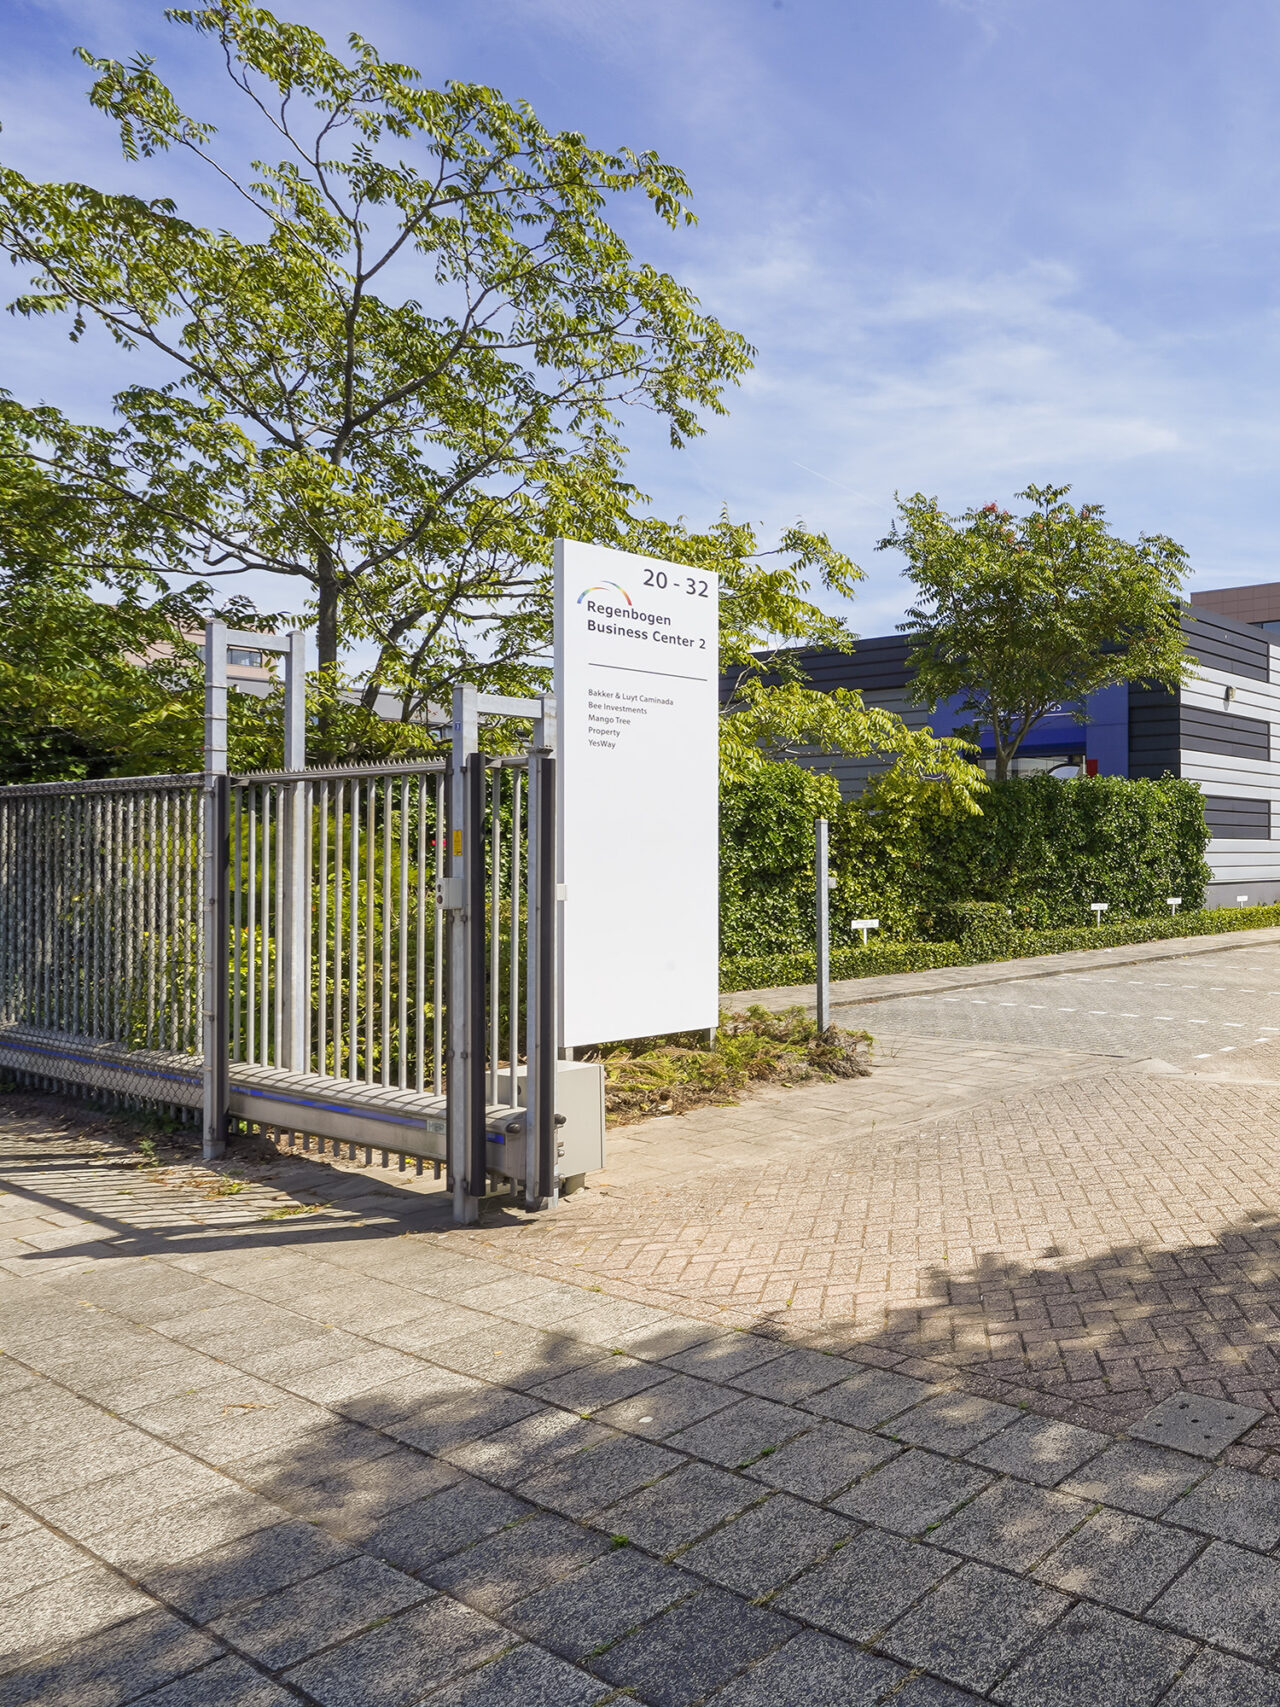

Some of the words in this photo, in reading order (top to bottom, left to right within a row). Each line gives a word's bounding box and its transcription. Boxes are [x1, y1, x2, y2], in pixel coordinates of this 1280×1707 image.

[643, 568, 668, 589] 20
[685, 577, 709, 598] 32
[587, 600, 671, 626] Regenbogen
[587, 619, 649, 641] Business
[652, 631, 695, 648] Center
[699, 638, 706, 650] 2
[588, 688, 614, 699] Bakker
[615, 691, 621, 699] &
[622, 693, 638, 703] Luyt
[639, 694, 674, 706] Caminada
[588, 701, 602, 710] Bee
[603, 703, 648, 715] Investments
[588, 713, 614, 725] Mango
[615, 716, 631, 725] Tree
[588, 726, 621, 738] Property
[588, 738, 616, 750] YesWay
